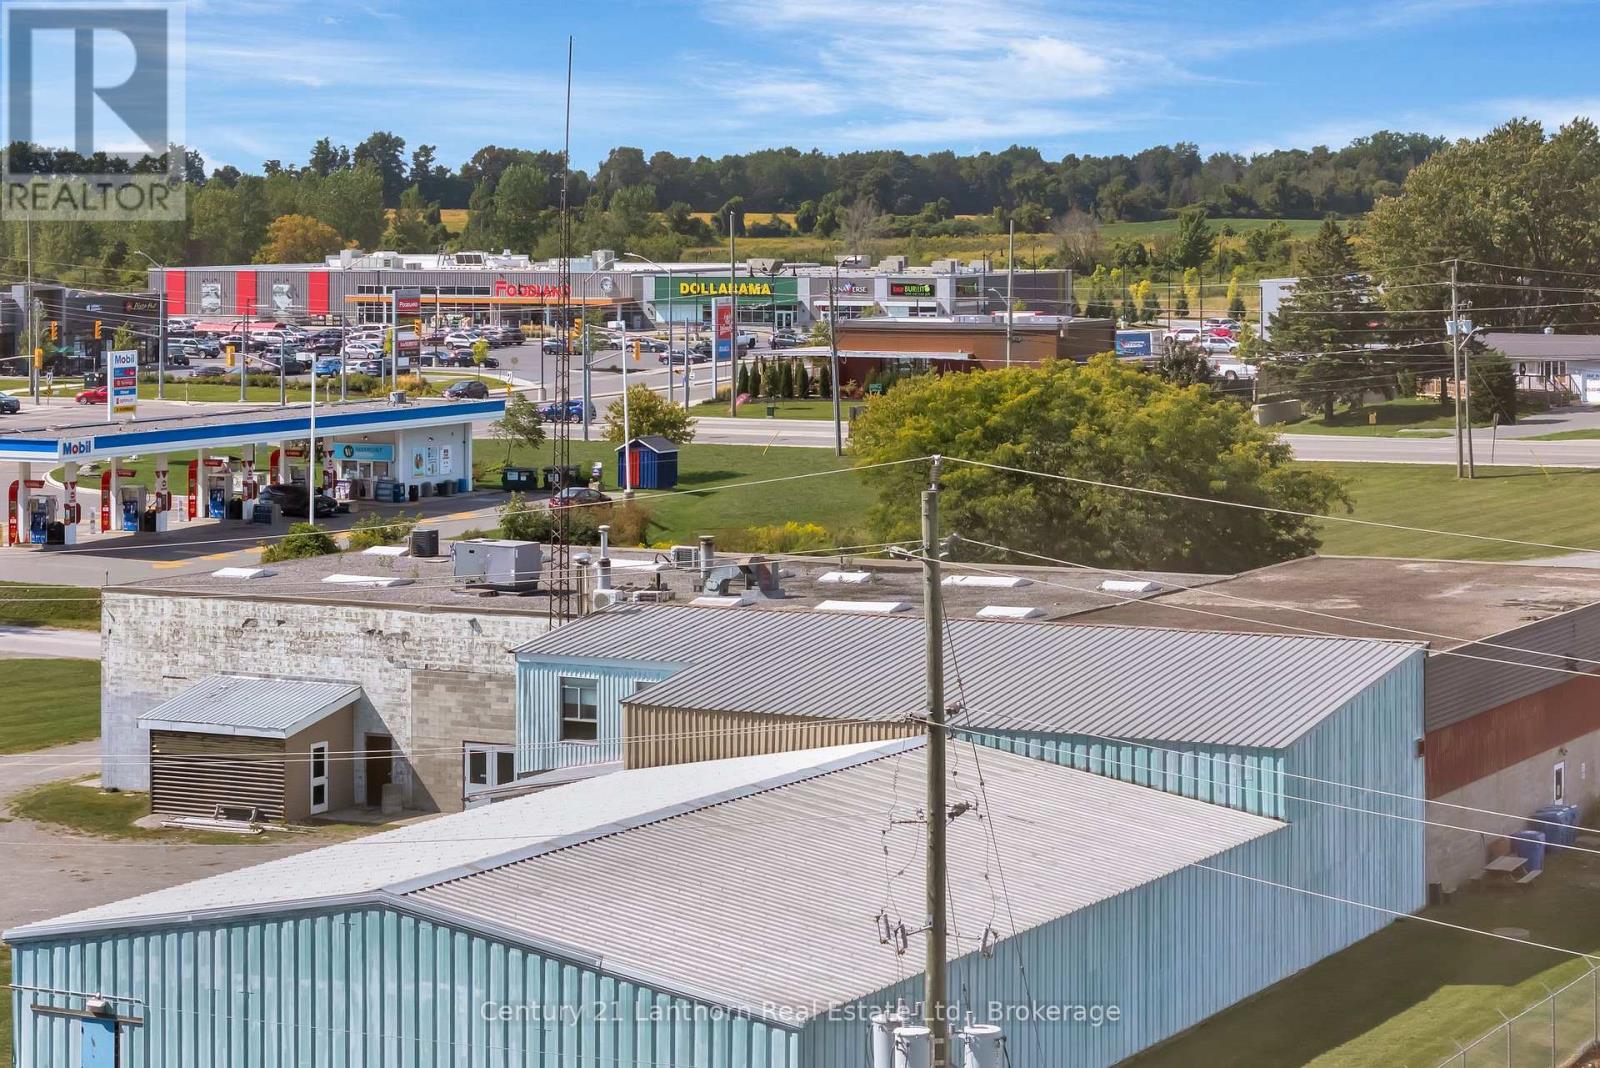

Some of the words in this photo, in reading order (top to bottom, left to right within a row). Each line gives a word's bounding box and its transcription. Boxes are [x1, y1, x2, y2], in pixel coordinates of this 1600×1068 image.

[680, 282, 771, 295] DOLLARAMA
[114, 354, 135, 364] Mobil
[62, 440, 92, 455] Mobil
